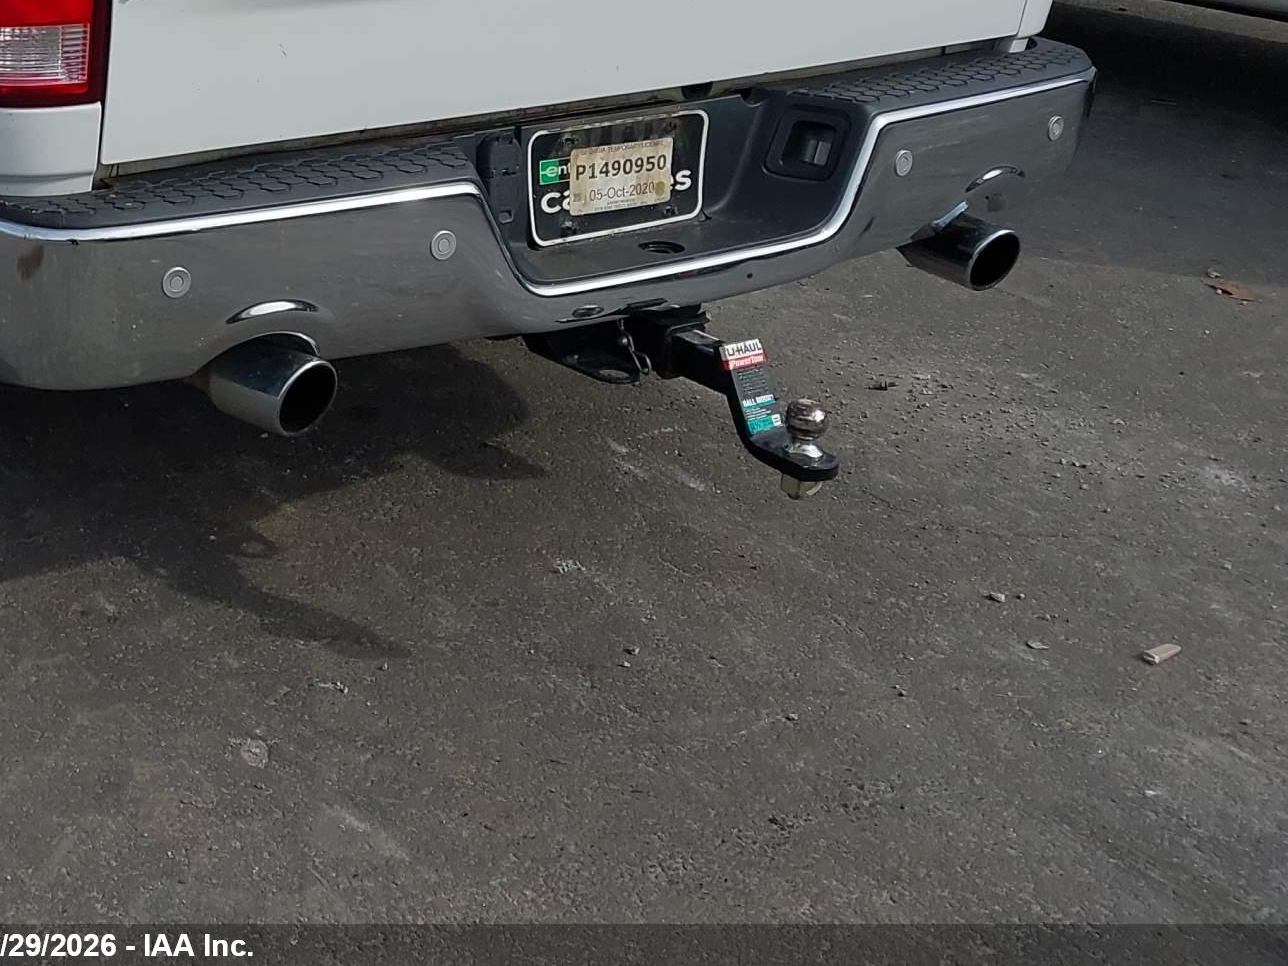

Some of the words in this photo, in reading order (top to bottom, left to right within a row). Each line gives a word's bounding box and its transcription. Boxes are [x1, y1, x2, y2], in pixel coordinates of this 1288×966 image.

[575, 154, 667, 181] P1490950
[589, 181, 655, 202] 05-Oct-2020
[726, 341, 762, 356] U-HAUL
